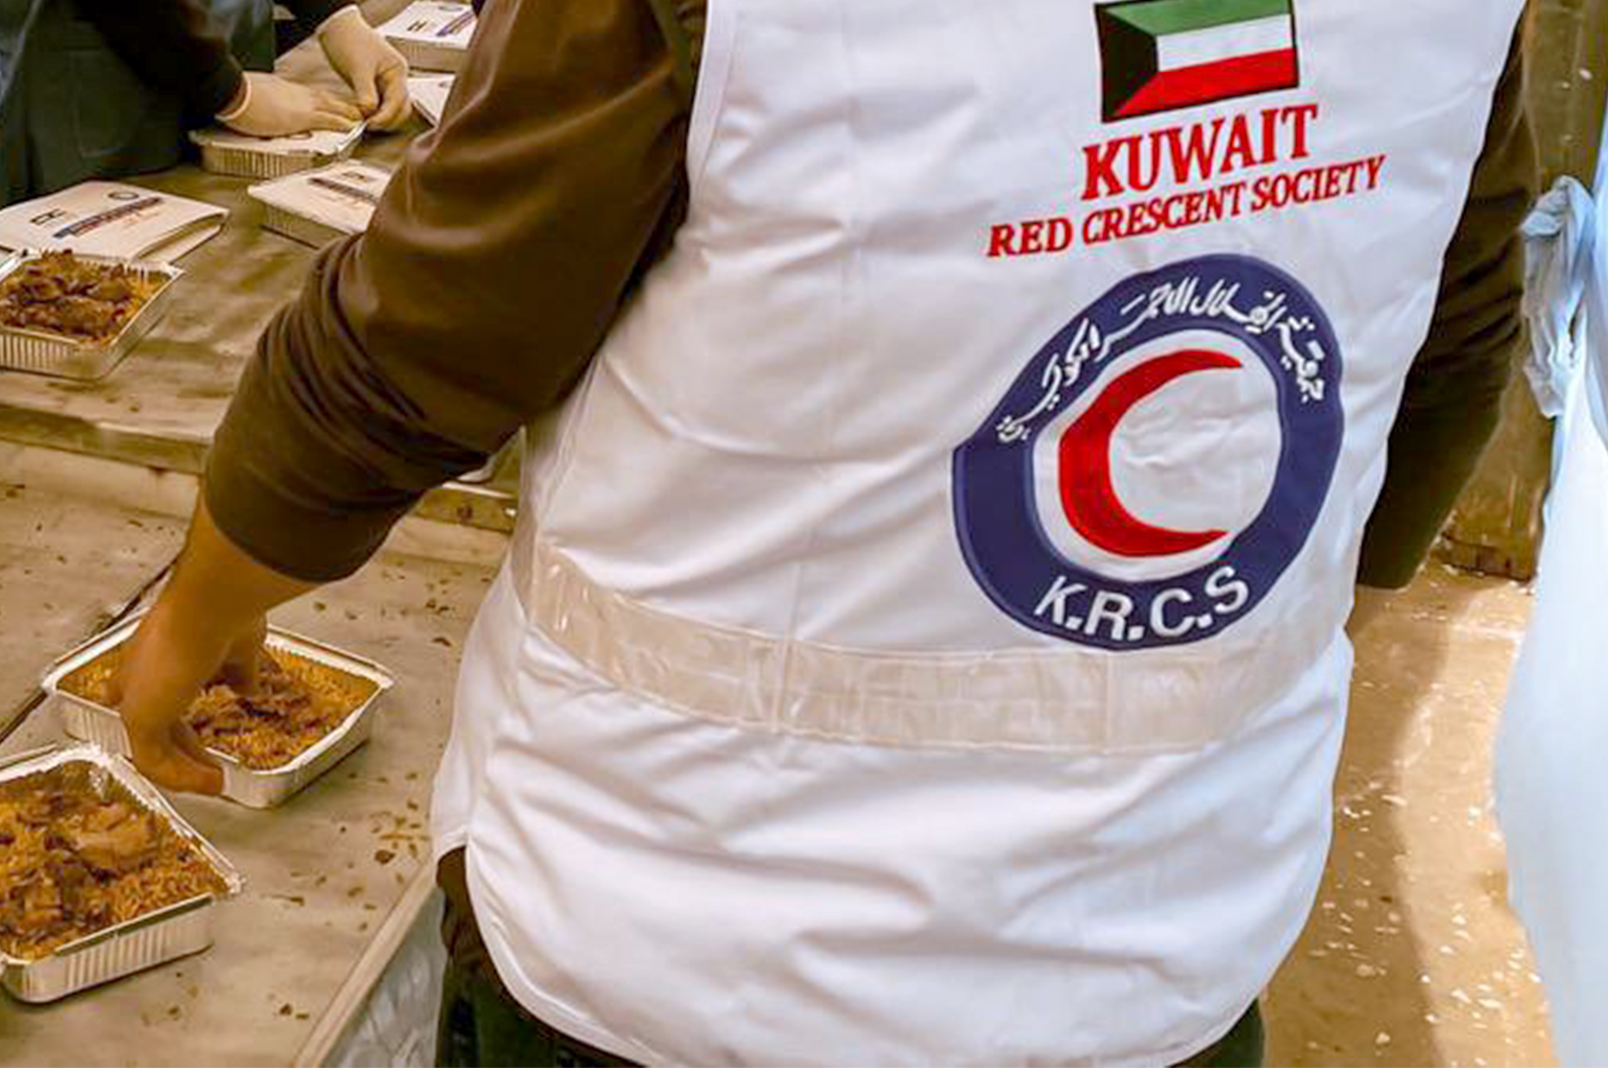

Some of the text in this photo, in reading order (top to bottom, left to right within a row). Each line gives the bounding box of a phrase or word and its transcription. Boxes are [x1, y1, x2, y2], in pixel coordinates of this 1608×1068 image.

[1081, 104, 1318, 200] KUWAIT
[987, 155, 1386, 258] RED CRESCENT SOCIETY
[1033, 565, 1249, 641] K.R.C.S
